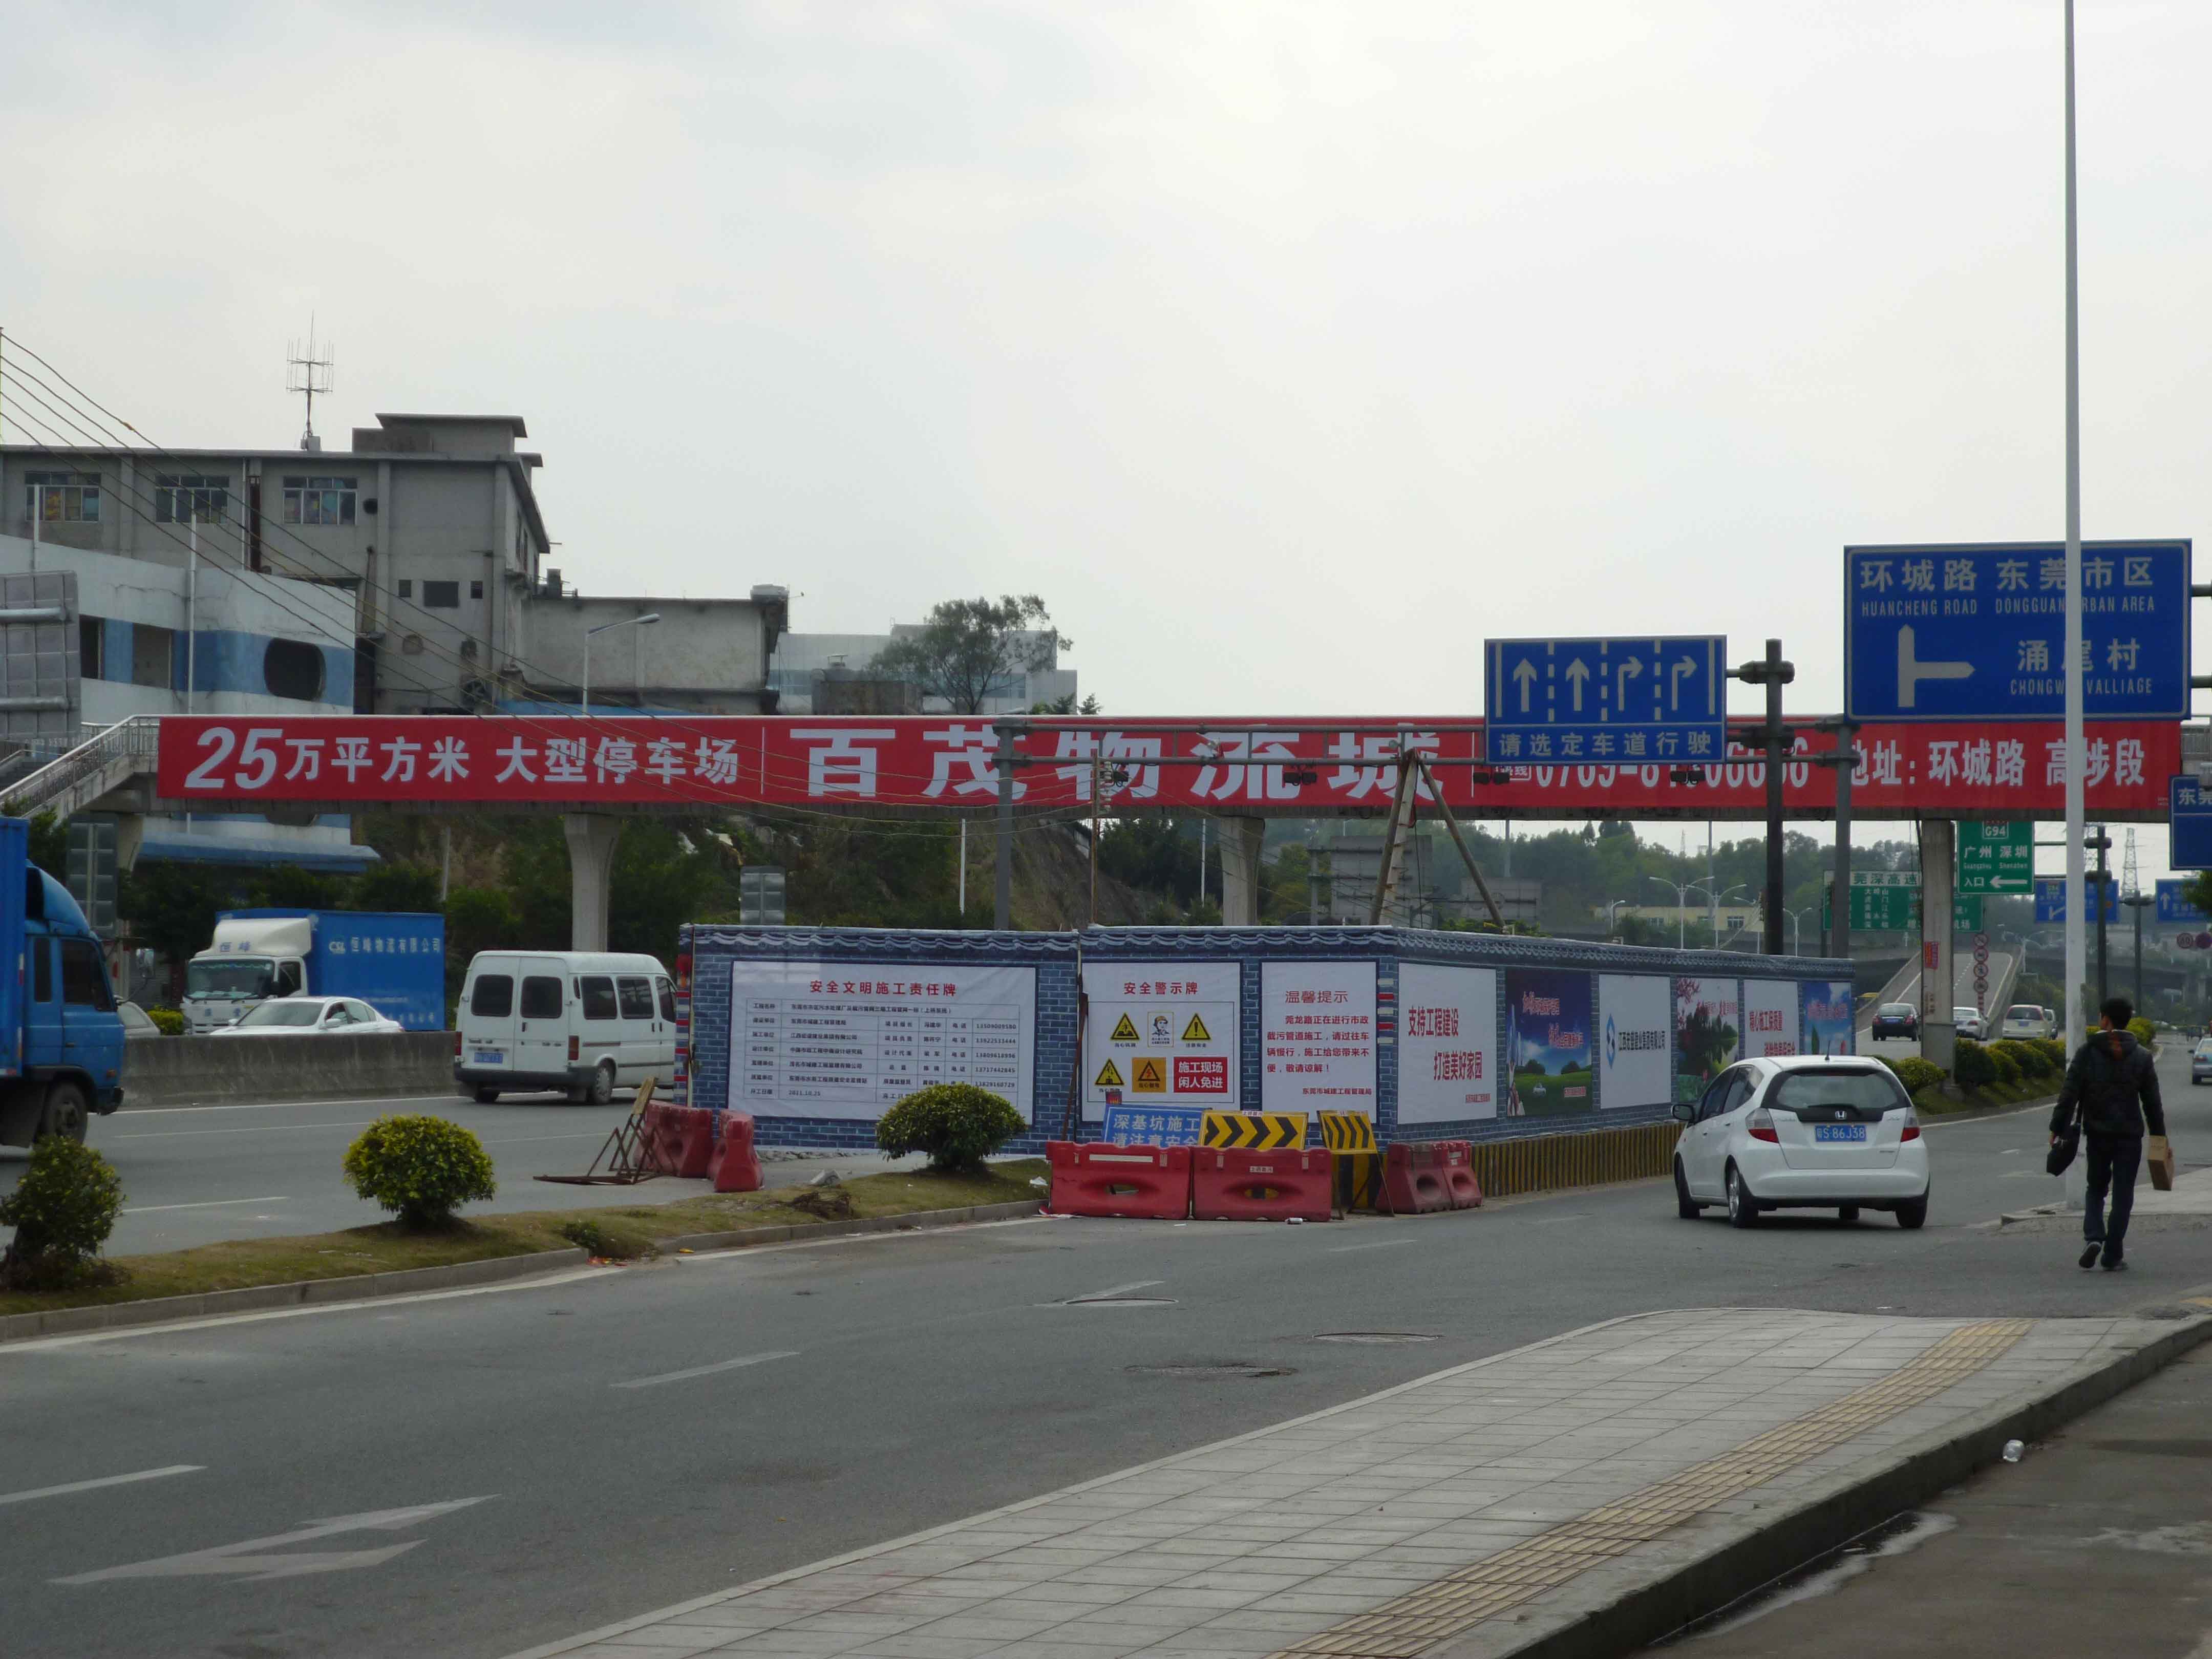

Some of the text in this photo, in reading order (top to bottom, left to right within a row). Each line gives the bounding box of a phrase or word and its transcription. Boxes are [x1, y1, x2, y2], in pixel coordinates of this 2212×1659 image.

[1860, 557, 2153, 593] 环城路 东莞市区
[1862, 595, 2155, 616] HUANCHENG ROAD DONGGUAN RBAN AREA
[2010, 678, 2153, 695] CHONGW VALLIAGE
[1499, 731, 1712, 757] 请选定车道行驶
[184, 726, 738, 790] 25万平方米 大型停车场
[790, 723, 1443, 800] 百茂物流城
[1985, 825, 2006, 836] G94
[1964, 845, 2028, 858] 广州 深圳
[1853, 873, 1918, 885] 莞深高速
[1964, 877, 1985, 887] 入口
[810, 980, 957, 997] 安全文明施工责任牌
[1124, 982, 1198, 995] 安全警示牌
[1285, 990, 1348, 1004] 温馨提示
[1285, 1015, 1369, 1025] 莞龙路正在进行市政
[1408, 1006, 1459, 1037] 支持工程建设
[1267, 1031, 1369, 1041] 截污管道施工，请过往车
[1178, 1061, 1223, 1074] 施工现场
[1267, 1064, 1330, 1073] 便，敬请谅解！
[1433, 1050, 1482, 1081] 打造美好家园
[1178, 1076, 1223, 1089] 闲人免进
[1113, 1114, 1200, 1132] 深基坑施工
